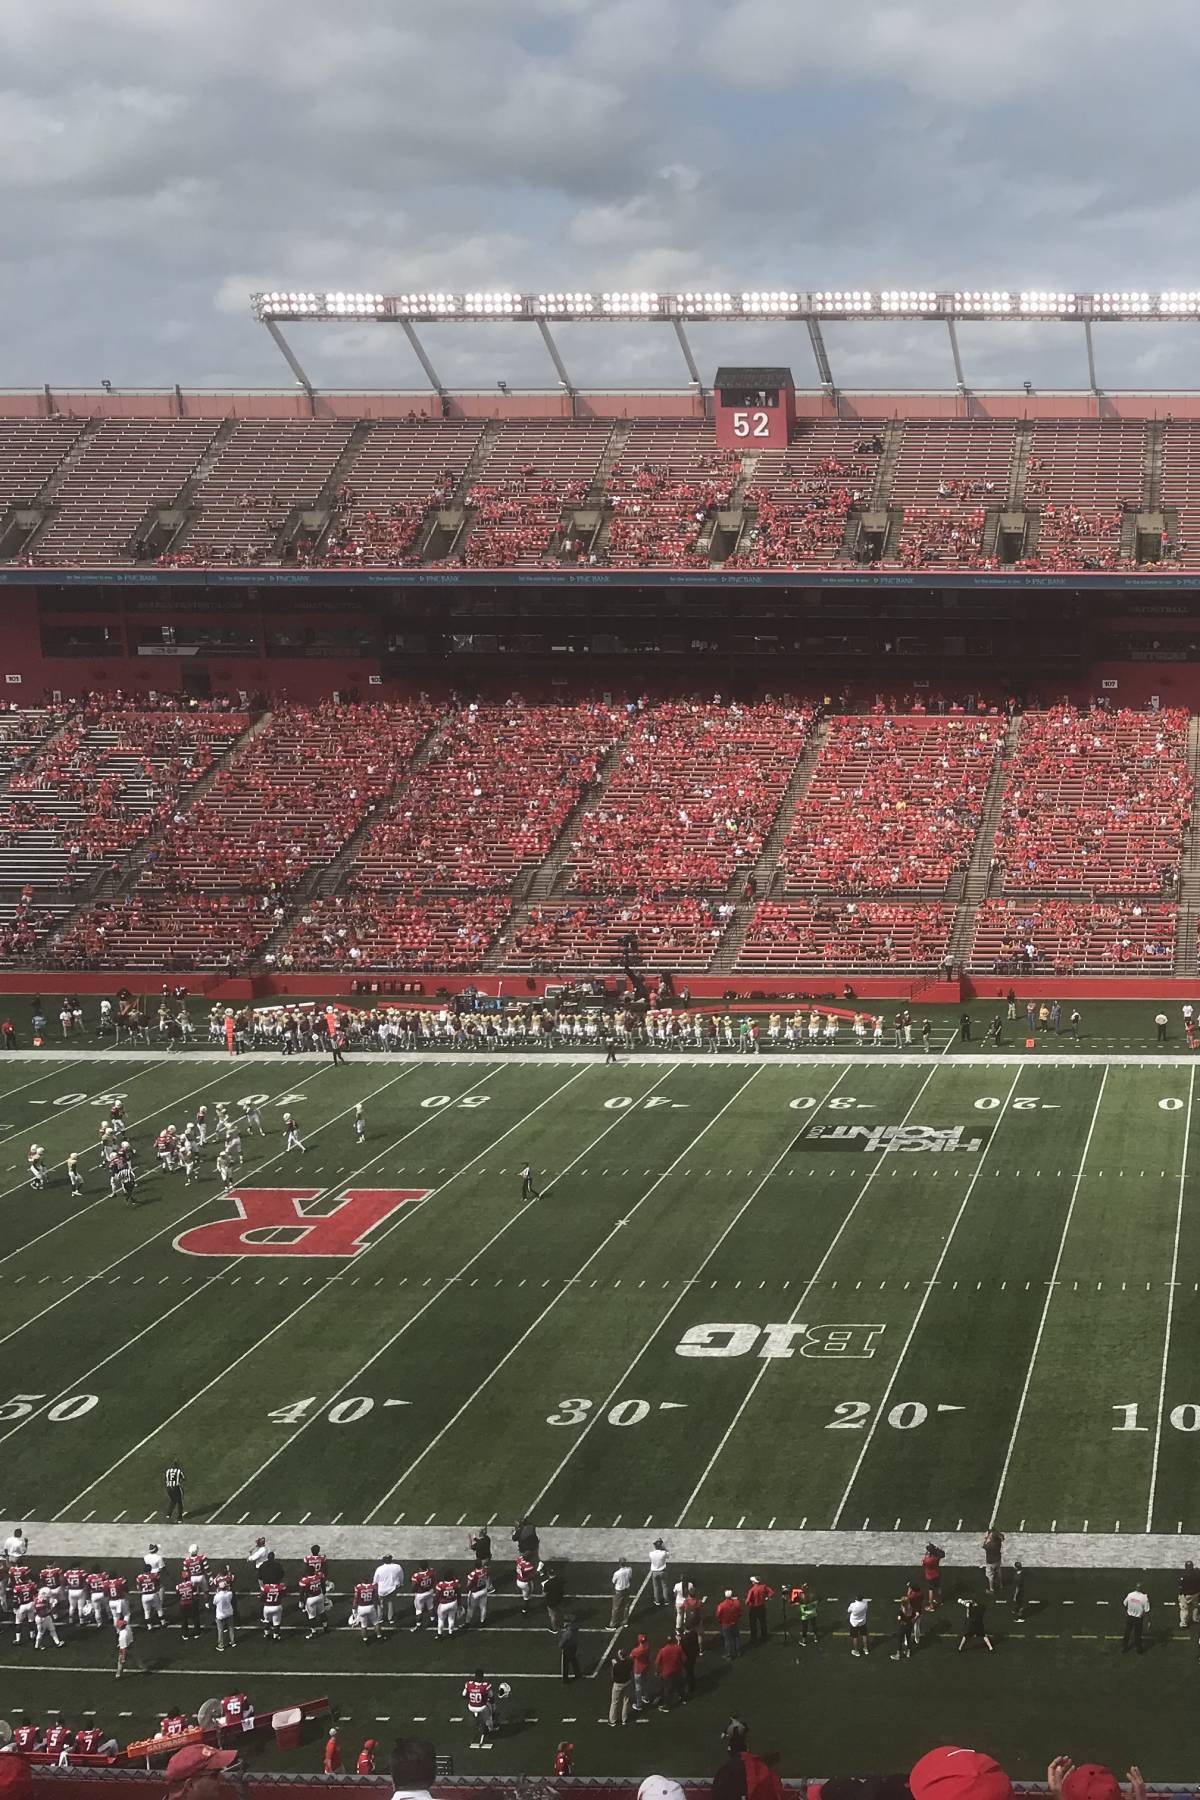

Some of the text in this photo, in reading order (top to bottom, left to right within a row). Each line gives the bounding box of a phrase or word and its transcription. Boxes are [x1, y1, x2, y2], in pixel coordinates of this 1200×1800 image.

[733, 412, 770, 437] 52
[237, 1094, 308, 1107] 40
[421, 1095, 491, 1108] 50
[604, 1096, 672, 1109] 40
[789, 1096, 857, 1110] 30
[973, 1096, 1041, 1110] 20
[820, 1125, 966, 1139] POINT
[863, 1138, 983, 1152] HIGH
[172, 1187, 436, 1258] R
[0, 1394, 99, 1422] 50
[267, 1396, 375, 1424] 40
[546, 1398, 651, 1427] 30
[824, 1401, 928, 1430] 20
[110, 1587, 117, 1597] 8
[142, 1583, 155, 1593] 23
[266, 1592, 280, 1603] 57
[470, 1693, 482, 1703] 50
[227, 1701, 241, 1715] 95
[20, 1733, 28, 1746] 3
[50, 1734, 58, 1747] 5
[84, 1739, 92, 1752] 7
[146, 1736, 188, 1752] GATORADE
